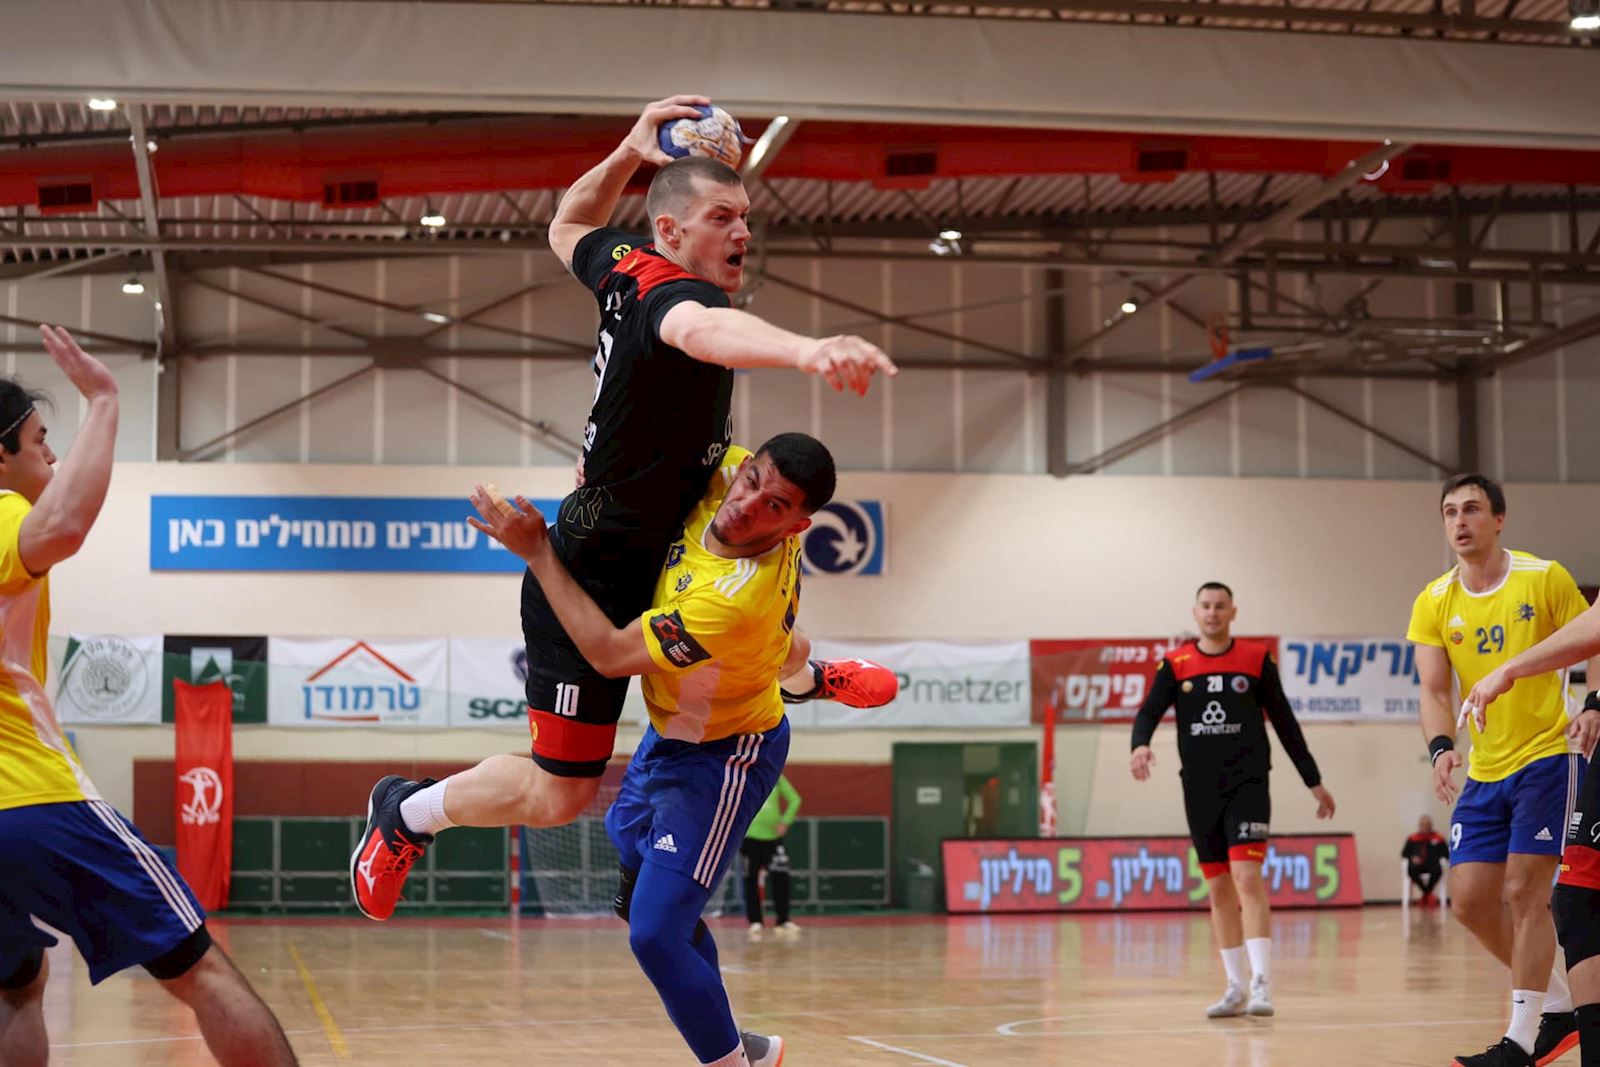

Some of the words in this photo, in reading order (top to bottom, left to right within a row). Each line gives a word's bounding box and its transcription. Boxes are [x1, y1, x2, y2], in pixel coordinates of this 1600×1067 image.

[168, 518, 225, 553] כאן
[235, 513, 376, 549] מתחילים
[386, 521, 479, 549] טובים
[1476, 625, 1505, 655] 29
[1287, 642, 1421, 686] וריקאר
[302, 682, 421, 720] טרמודן
[554, 682, 580, 717] 10
[893, 669, 1027, 706] Pmetzer
[468, 697, 530, 720] SCA
[1450, 822, 1463, 851] 9
[1057, 847, 1082, 904] 5
[1187, 847, 1211, 902] 5
[1261, 846, 1311, 891] מילי
[1315, 844, 1339, 899] 5
